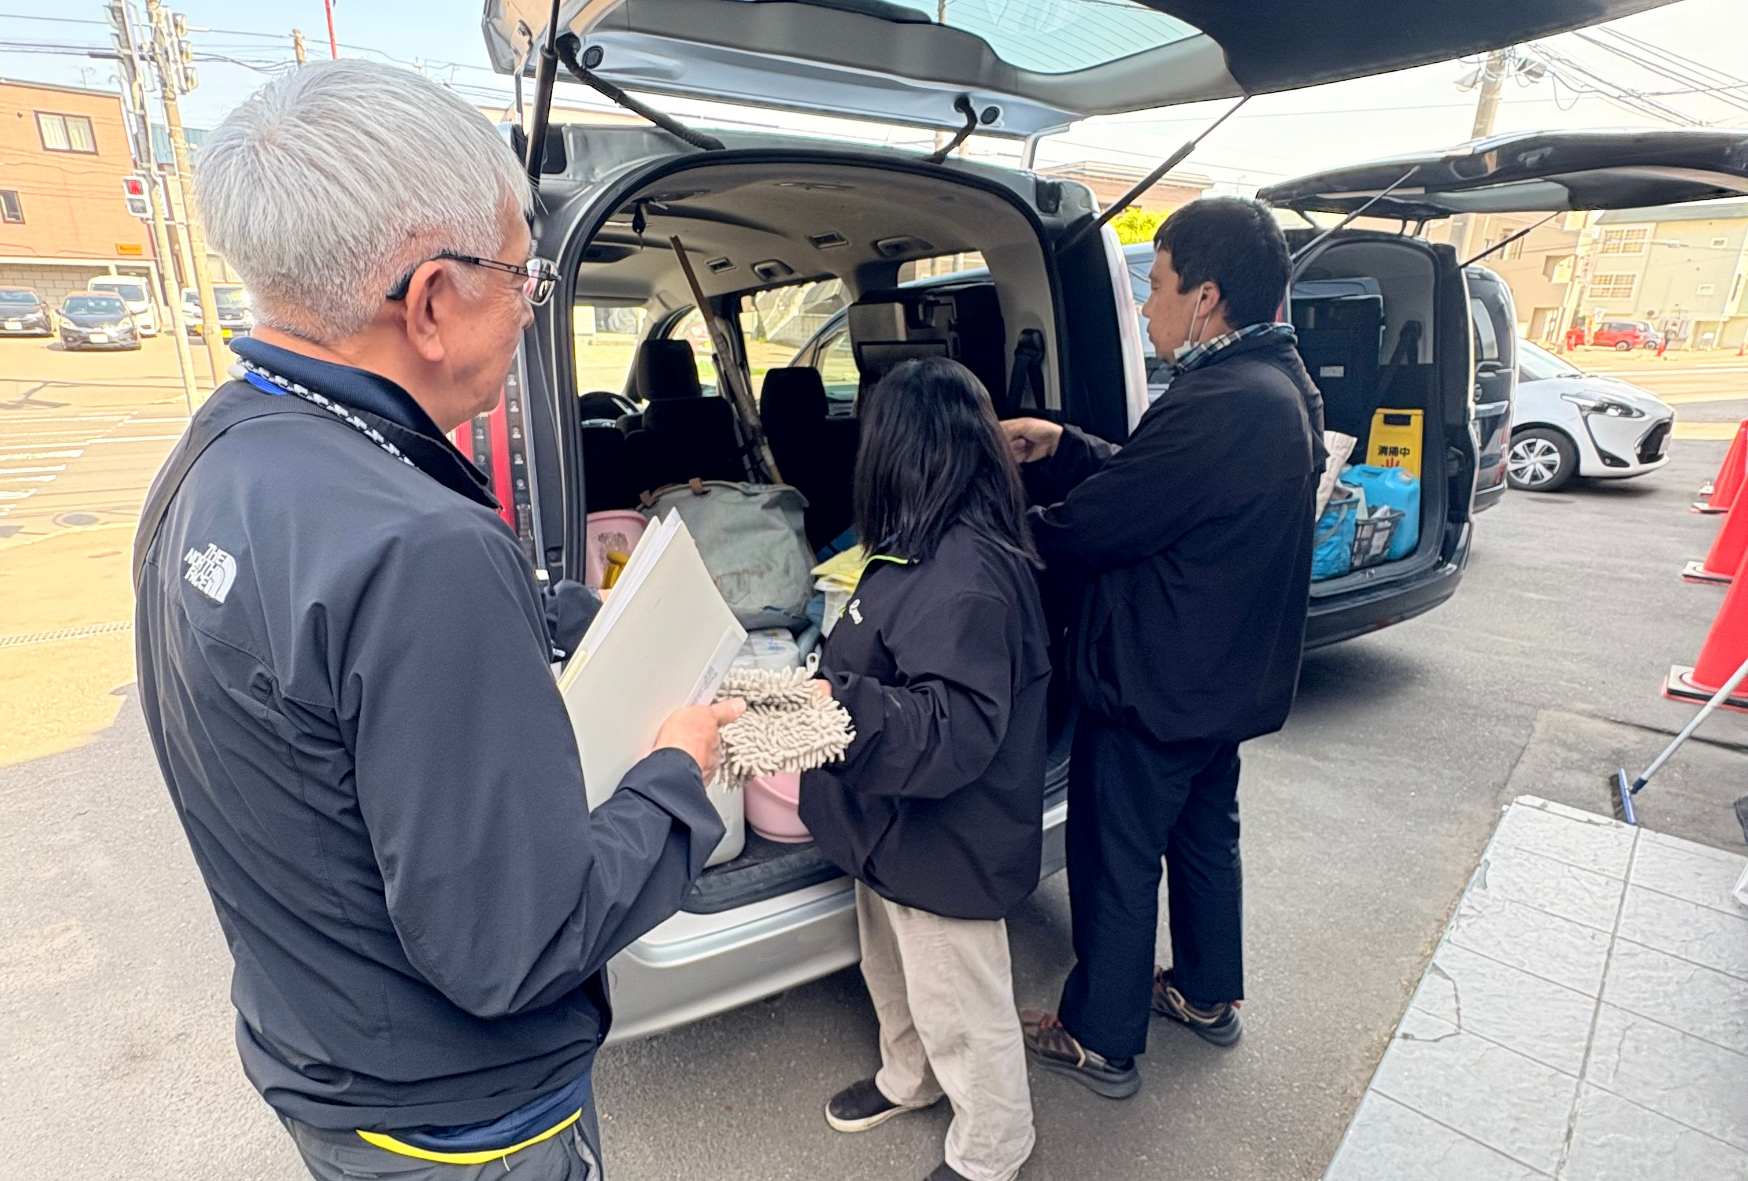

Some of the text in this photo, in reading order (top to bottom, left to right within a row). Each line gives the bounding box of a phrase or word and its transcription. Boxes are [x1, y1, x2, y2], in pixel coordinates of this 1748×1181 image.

[184, 547, 217, 579] NORTH
[204, 543, 228, 566] THE
[184, 566, 210, 592] FACE
